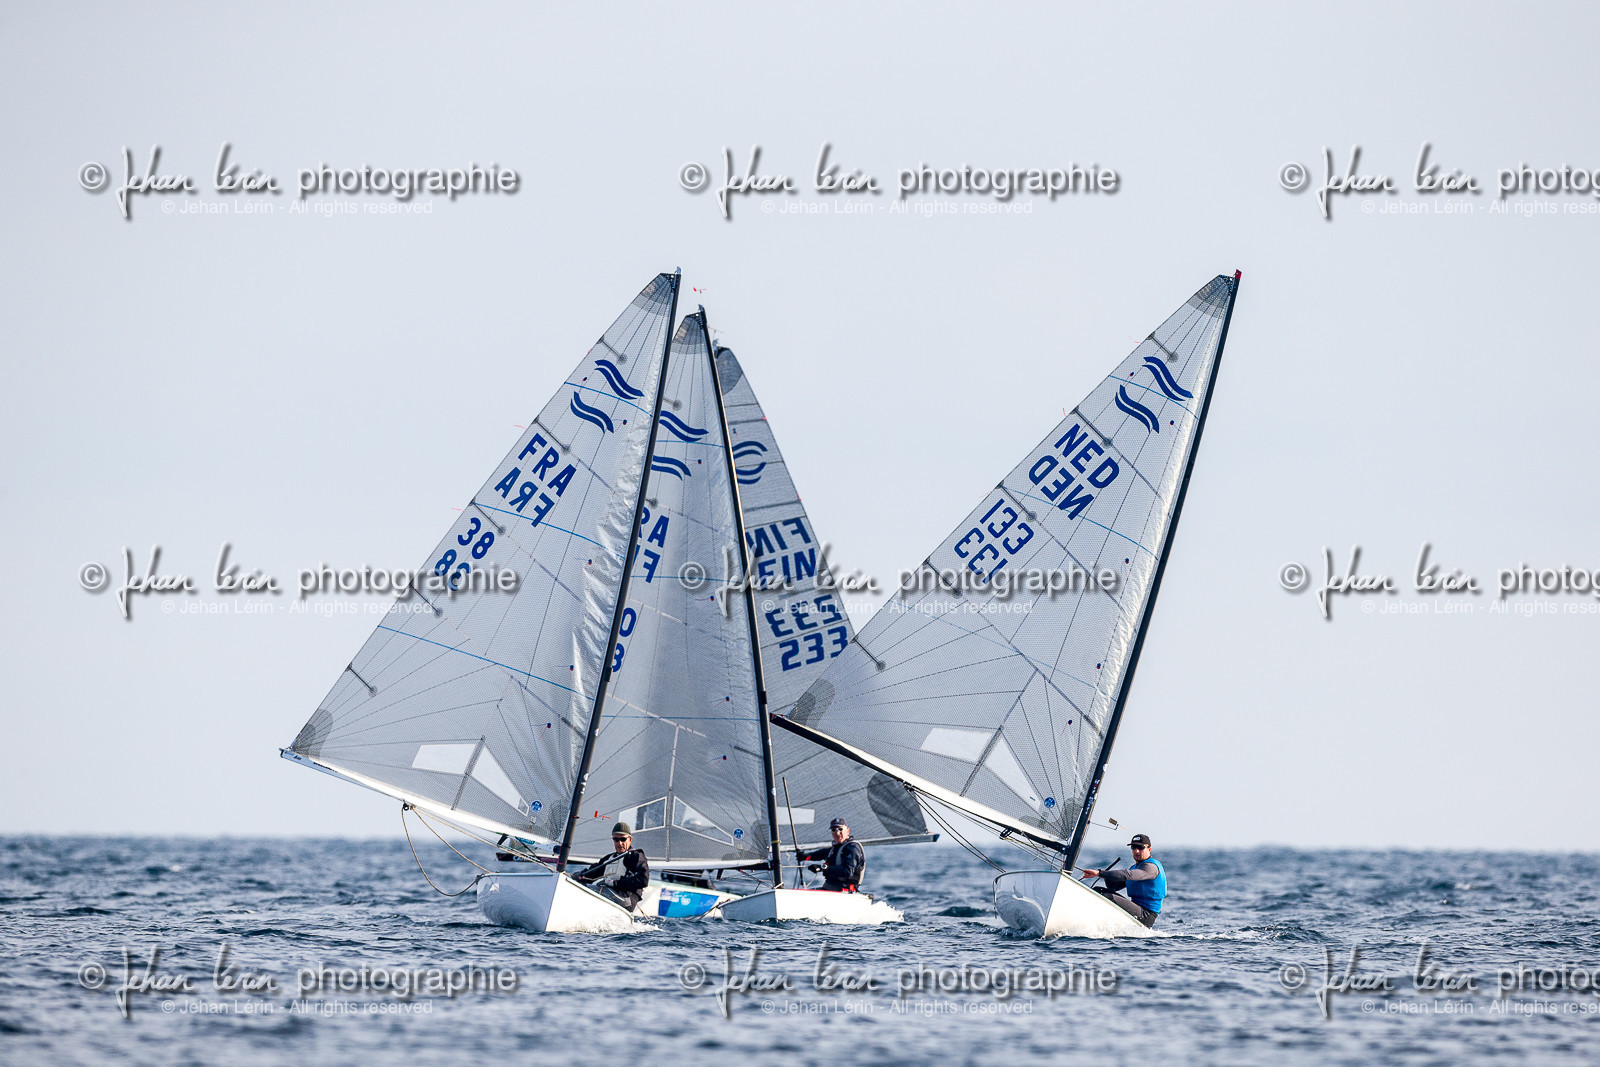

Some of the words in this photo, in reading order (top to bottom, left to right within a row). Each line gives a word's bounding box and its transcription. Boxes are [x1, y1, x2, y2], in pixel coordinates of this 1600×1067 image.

[518, 433, 577, 497] FRA
[1054, 423, 1120, 489] NED
[458, 517, 495, 560] 38
[980, 498, 1034, 556] 133
[779, 625, 848, 672] 233
